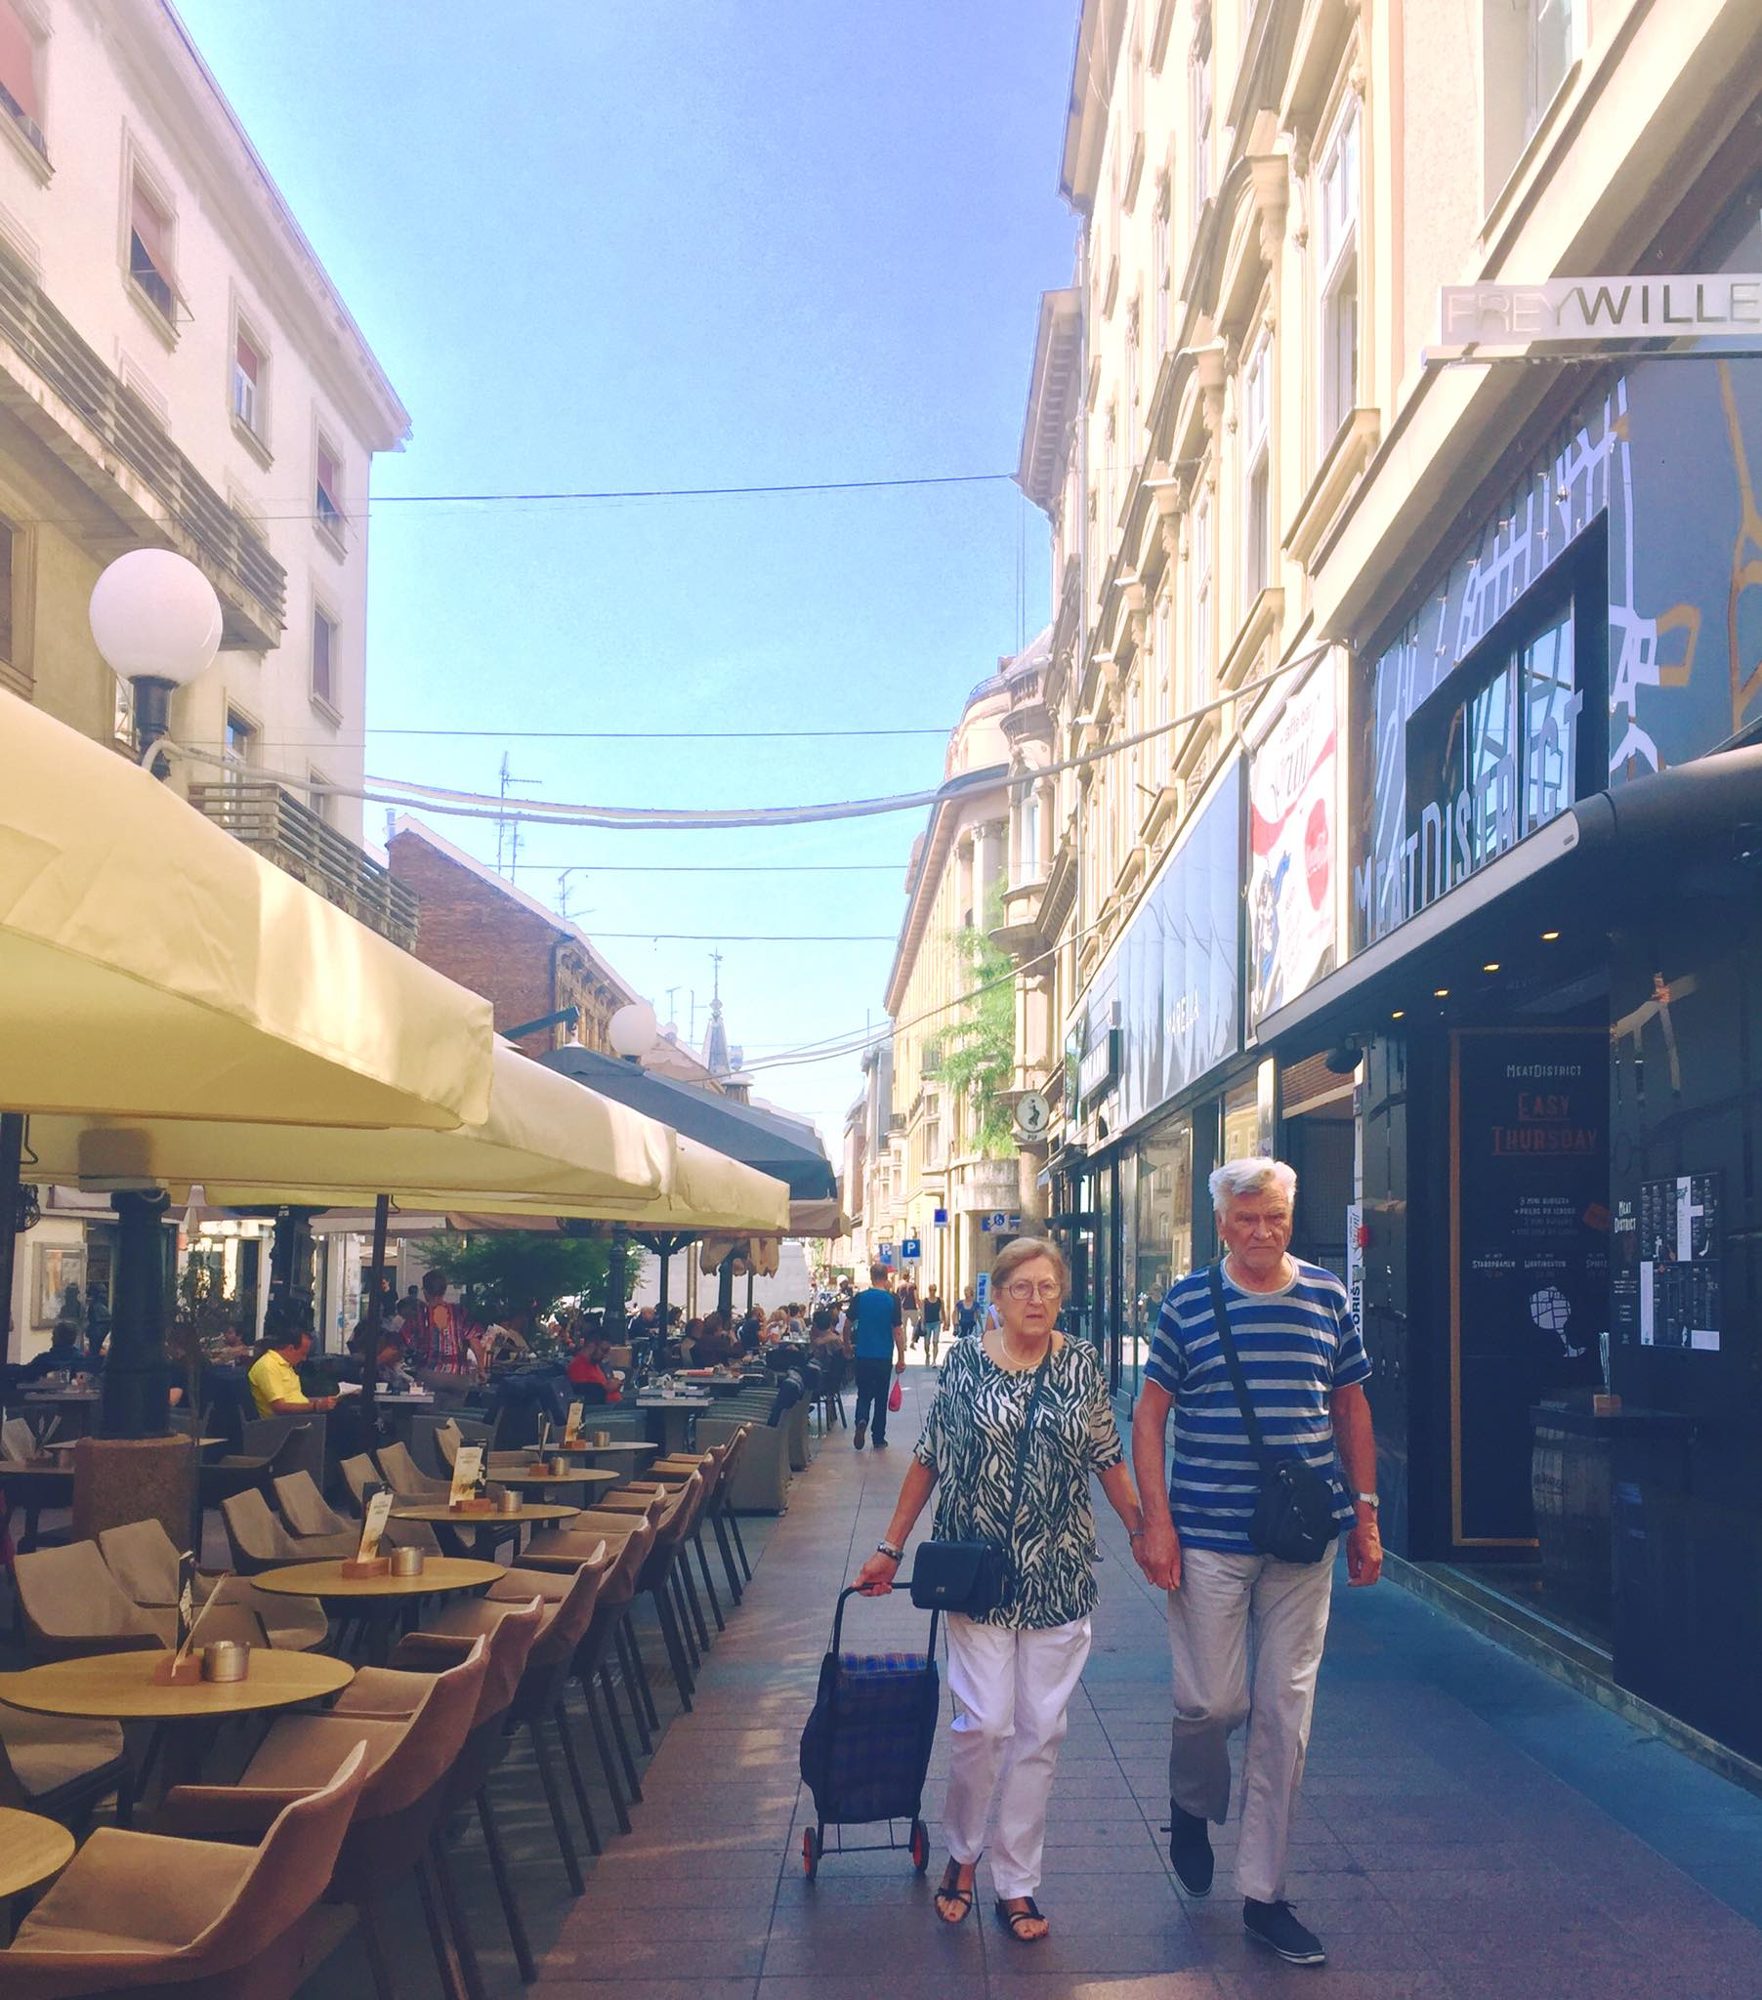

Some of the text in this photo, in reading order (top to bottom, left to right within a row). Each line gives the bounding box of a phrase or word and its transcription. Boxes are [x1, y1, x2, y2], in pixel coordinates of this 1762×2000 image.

[1448, 281, 1762, 333] FREYWILLE
[1518, 1093, 1570, 1119] EASY
[1491, 1126, 1598, 1153] THURSDAY
[907, 1241, 916, 1255] P
